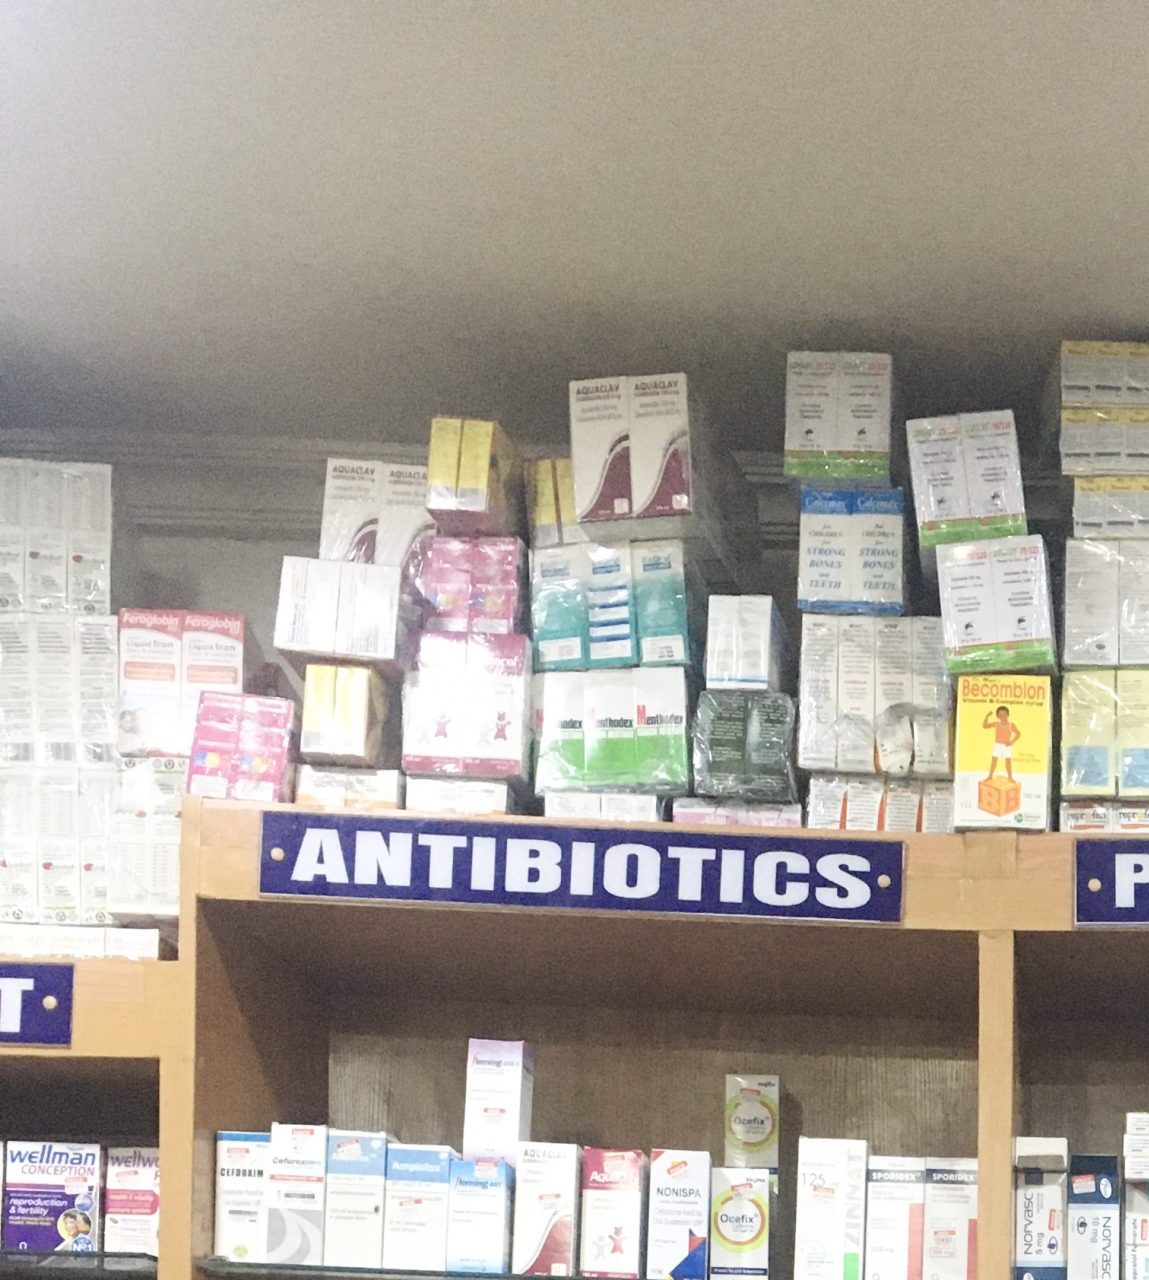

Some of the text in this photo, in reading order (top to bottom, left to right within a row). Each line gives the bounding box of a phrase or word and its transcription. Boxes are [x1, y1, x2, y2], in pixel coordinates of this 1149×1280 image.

[290, 827, 873, 911] ANTIBIOTICS
[10, 1144, 96, 1166] wellman
[21, 1165, 95, 1176] CONCEPTION
[872, 1171, 916, 1182] SPORIDEX
[932, 1173, 975, 1181] SPORIDEX
[656, 1187, 702, 1198] NONISPA
[719, 1213, 755, 1225] Ocefix
